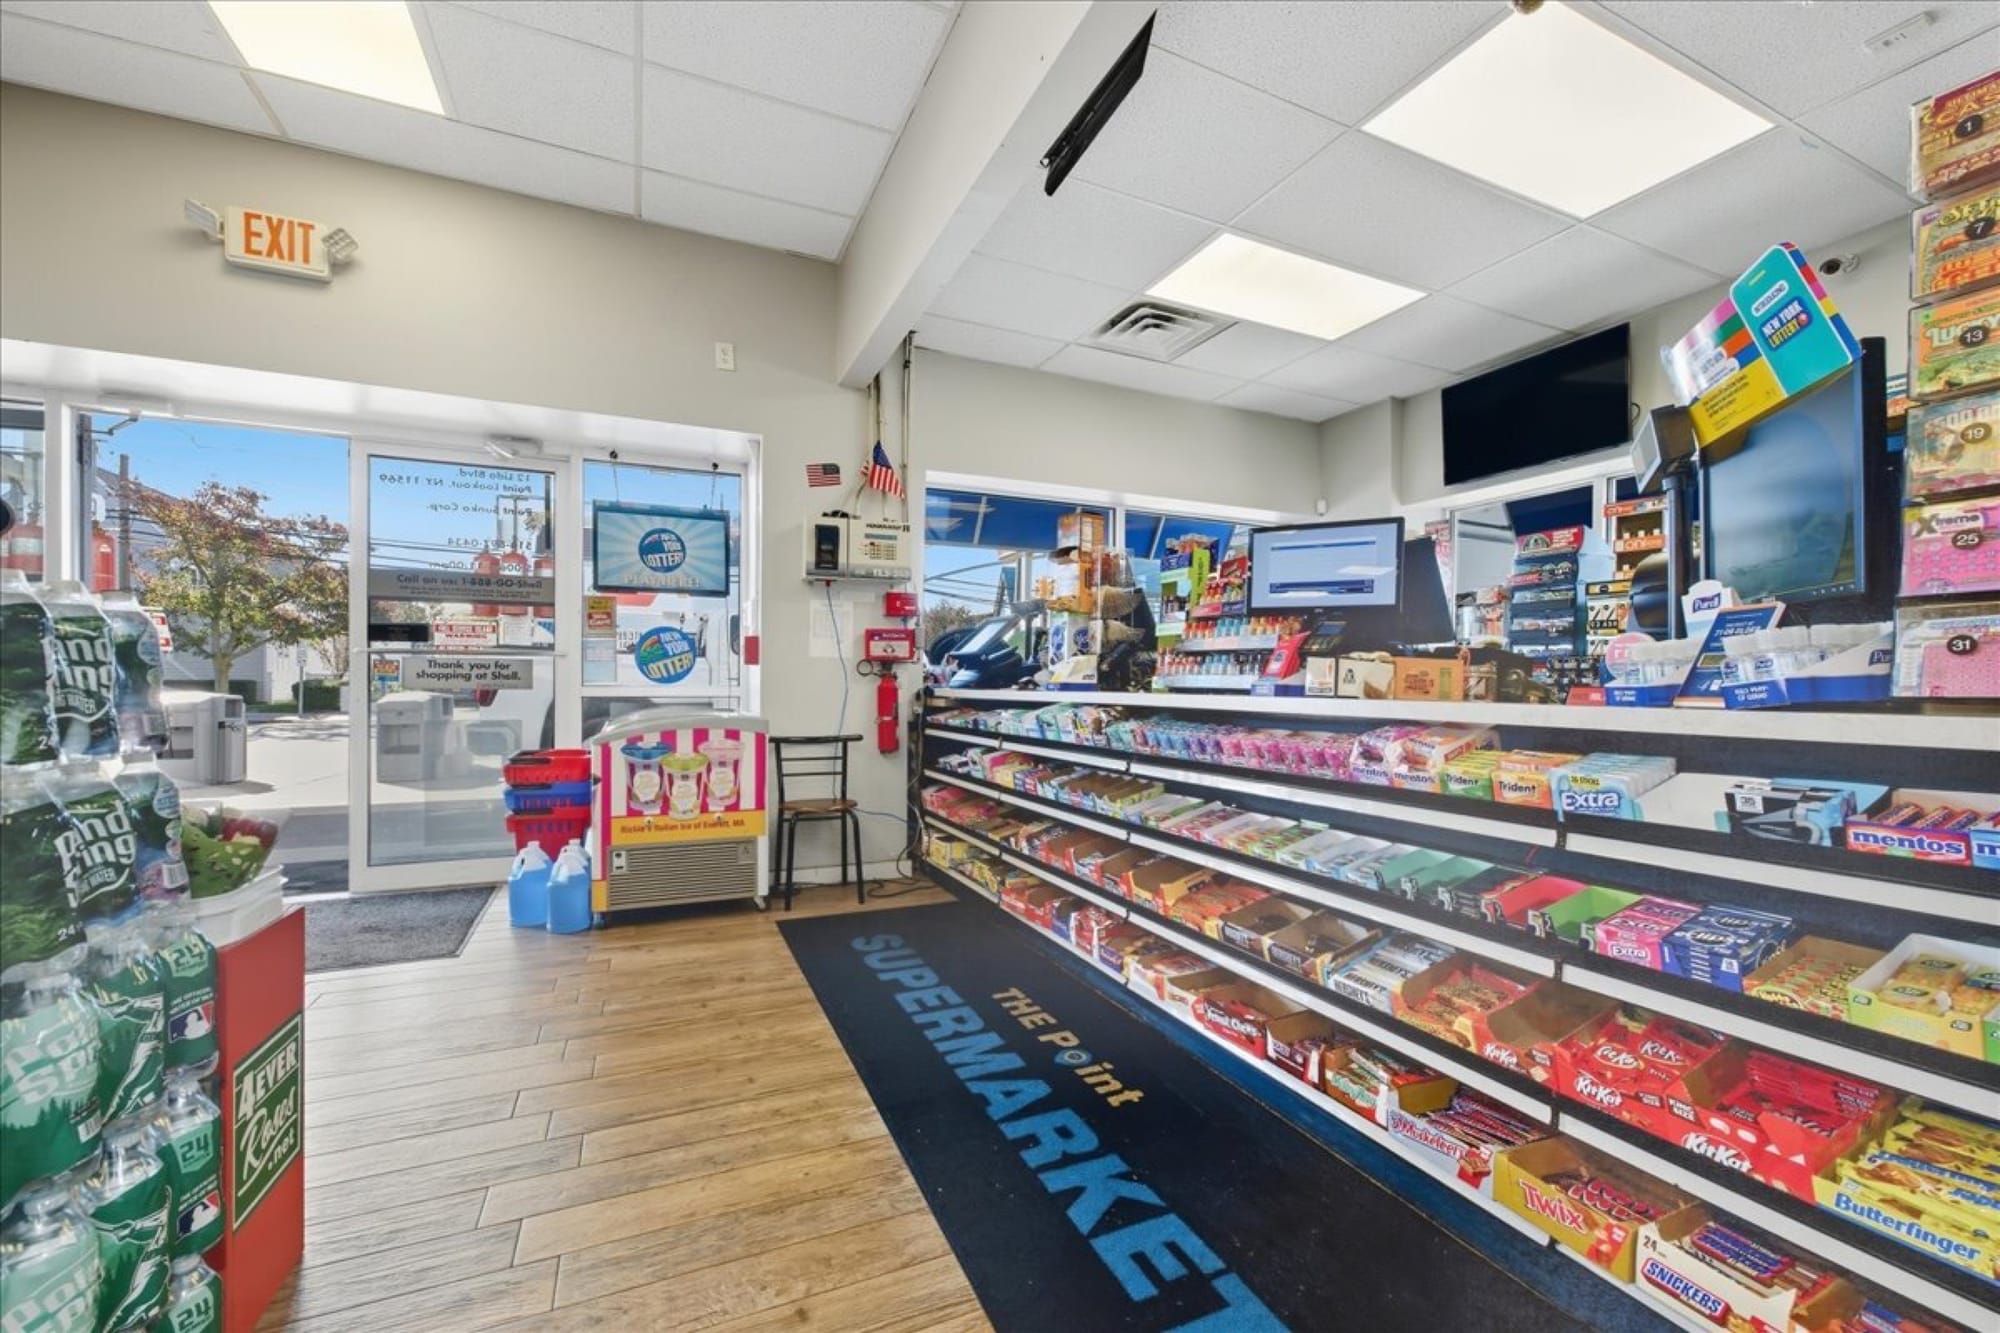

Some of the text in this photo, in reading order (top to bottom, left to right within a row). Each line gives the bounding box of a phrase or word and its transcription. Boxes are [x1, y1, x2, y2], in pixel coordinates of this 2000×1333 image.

[243, 211, 315, 266] EXIT
[1965, 329, 1984, 344] 13
[1967, 427, 1985, 440] 19
[1956, 533, 1979, 546] 25
[397, 573, 419, 583] Call
[1952, 639, 1971, 651] 31
[427, 659, 513, 672] Thank you for
[644, 655, 693, 679] LOTTERY
[416, 671, 521, 683] shopping at Shell.
[1445, 773, 1480, 786] Trident
[1498, 780, 1537, 794] Trident
[1560, 790, 1621, 811] Extra
[1852, 830, 1965, 856] mentos
[173, 942, 204, 968] 24
[1612, 945, 1648, 959] Extra
[992, 987, 1056, 1031] THE
[237, 1039, 298, 1121] 4EVER
[179, 1132, 209, 1164] 24
[1684, 1129, 1753, 1173] KitKat
[1833, 1191, 1982, 1263] Butterfinger
[1643, 1235, 1658, 1252] 24
[1645, 1261, 1722, 1315] SNICKERS
[176, 1297, 212, 1332] 24
